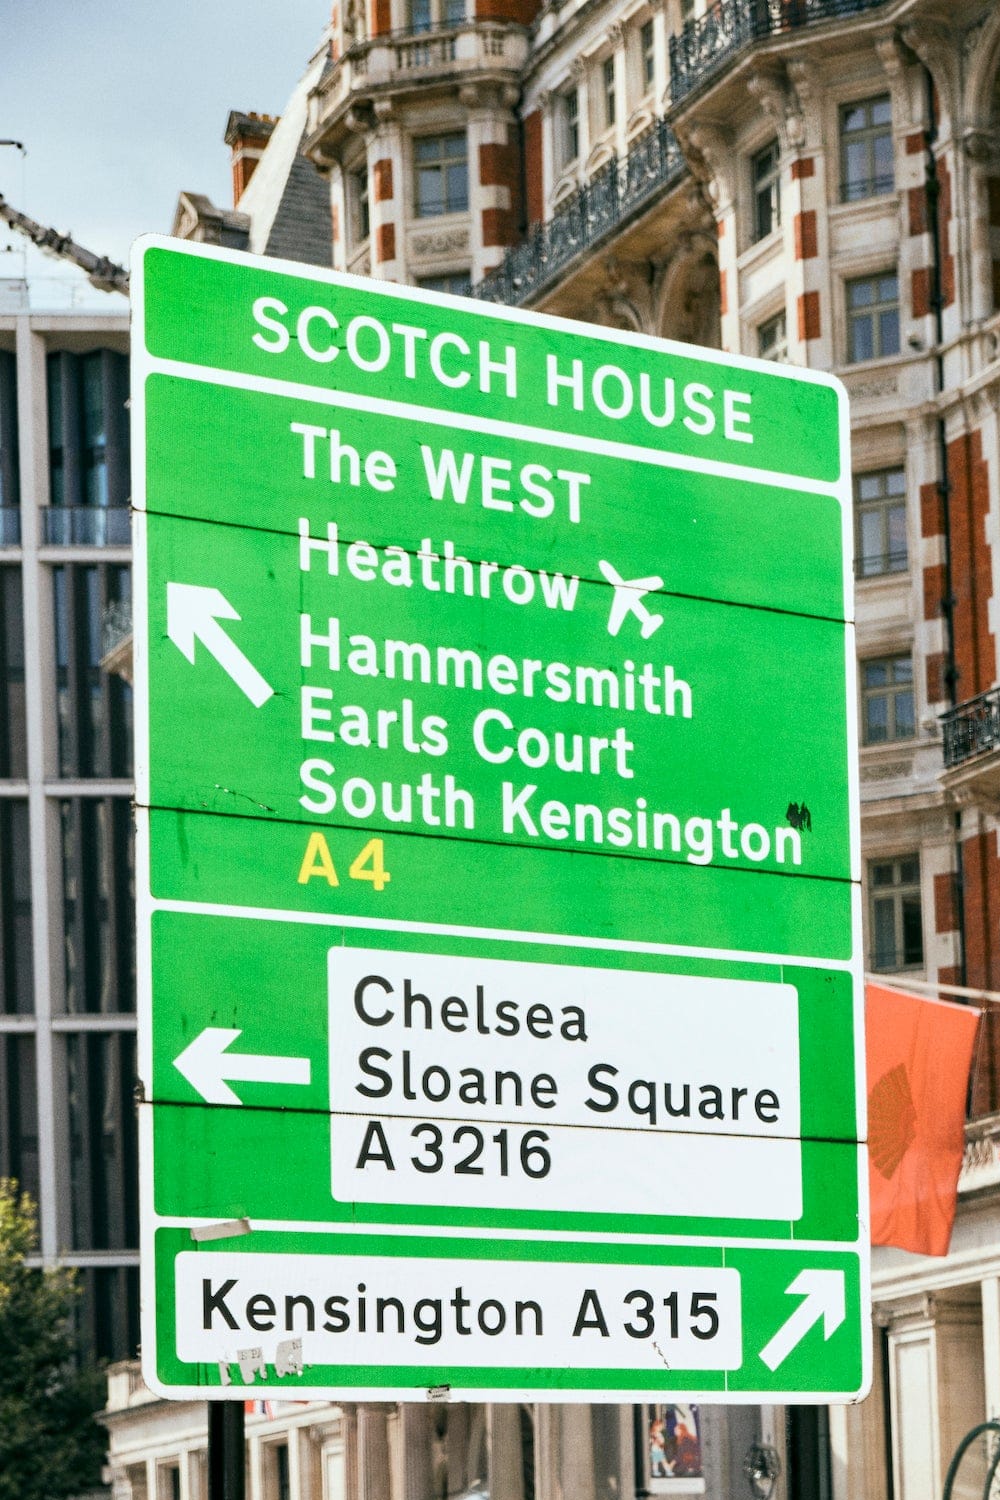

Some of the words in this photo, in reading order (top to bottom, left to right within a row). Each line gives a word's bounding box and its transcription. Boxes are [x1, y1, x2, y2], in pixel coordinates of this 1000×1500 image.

[251, 296, 518, 399] SCOTCH
[546, 353, 754, 444] HOUSE
[290, 421, 397, 492] The
[420, 444, 592, 524] WEST
[298, 517, 580, 611] Heathrow
[299, 613, 693, 719] Hammersmith
[300, 685, 449, 757] Earls
[472, 708, 634, 779] Court
[298, 758, 475, 830] South
[502, 781, 803, 866] Kensington
[297, 831, 391, 891] A4
[354, 975, 588, 1042] Chelsea
[355, 1046, 558, 1109] Sloane
[584, 1063, 780, 1125] Square
[202, 1278, 543, 1346] Kensington
